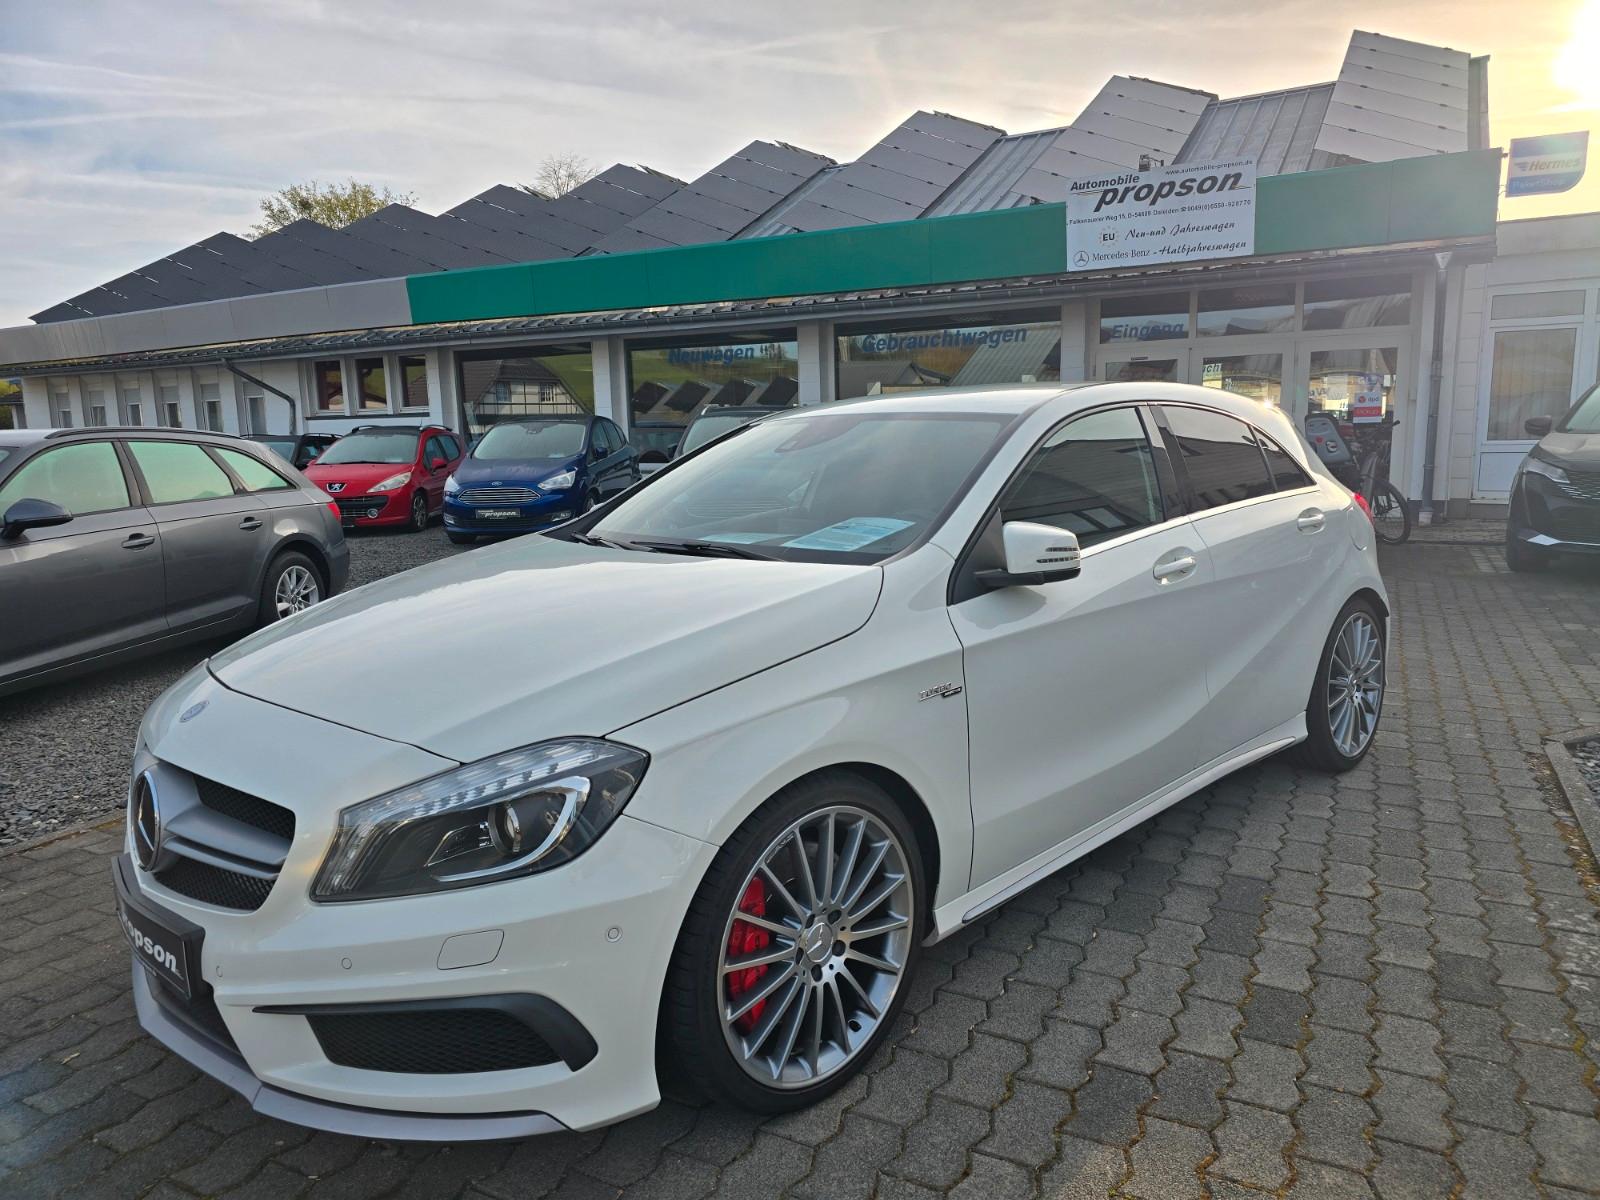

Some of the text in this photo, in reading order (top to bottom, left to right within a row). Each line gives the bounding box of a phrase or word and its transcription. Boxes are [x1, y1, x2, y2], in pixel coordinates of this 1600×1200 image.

[1529, 158, 1580, 171] Hermes
[1070, 174, 1140, 192] Automobile
[1093, 171, 1243, 212] propson
[1102, 232, 1116, 242] EU
[1169, 221, 1235, 237] Jahreswagen
[1092, 251, 1129, 262] Mercedes
[1130, 248, 1151, 258] Benz
[862, 327, 1028, 352] Gebrauchtwagen
[1111, 322, 1185, 342] Eingang
[667, 346, 755, 366] Neuwagen
